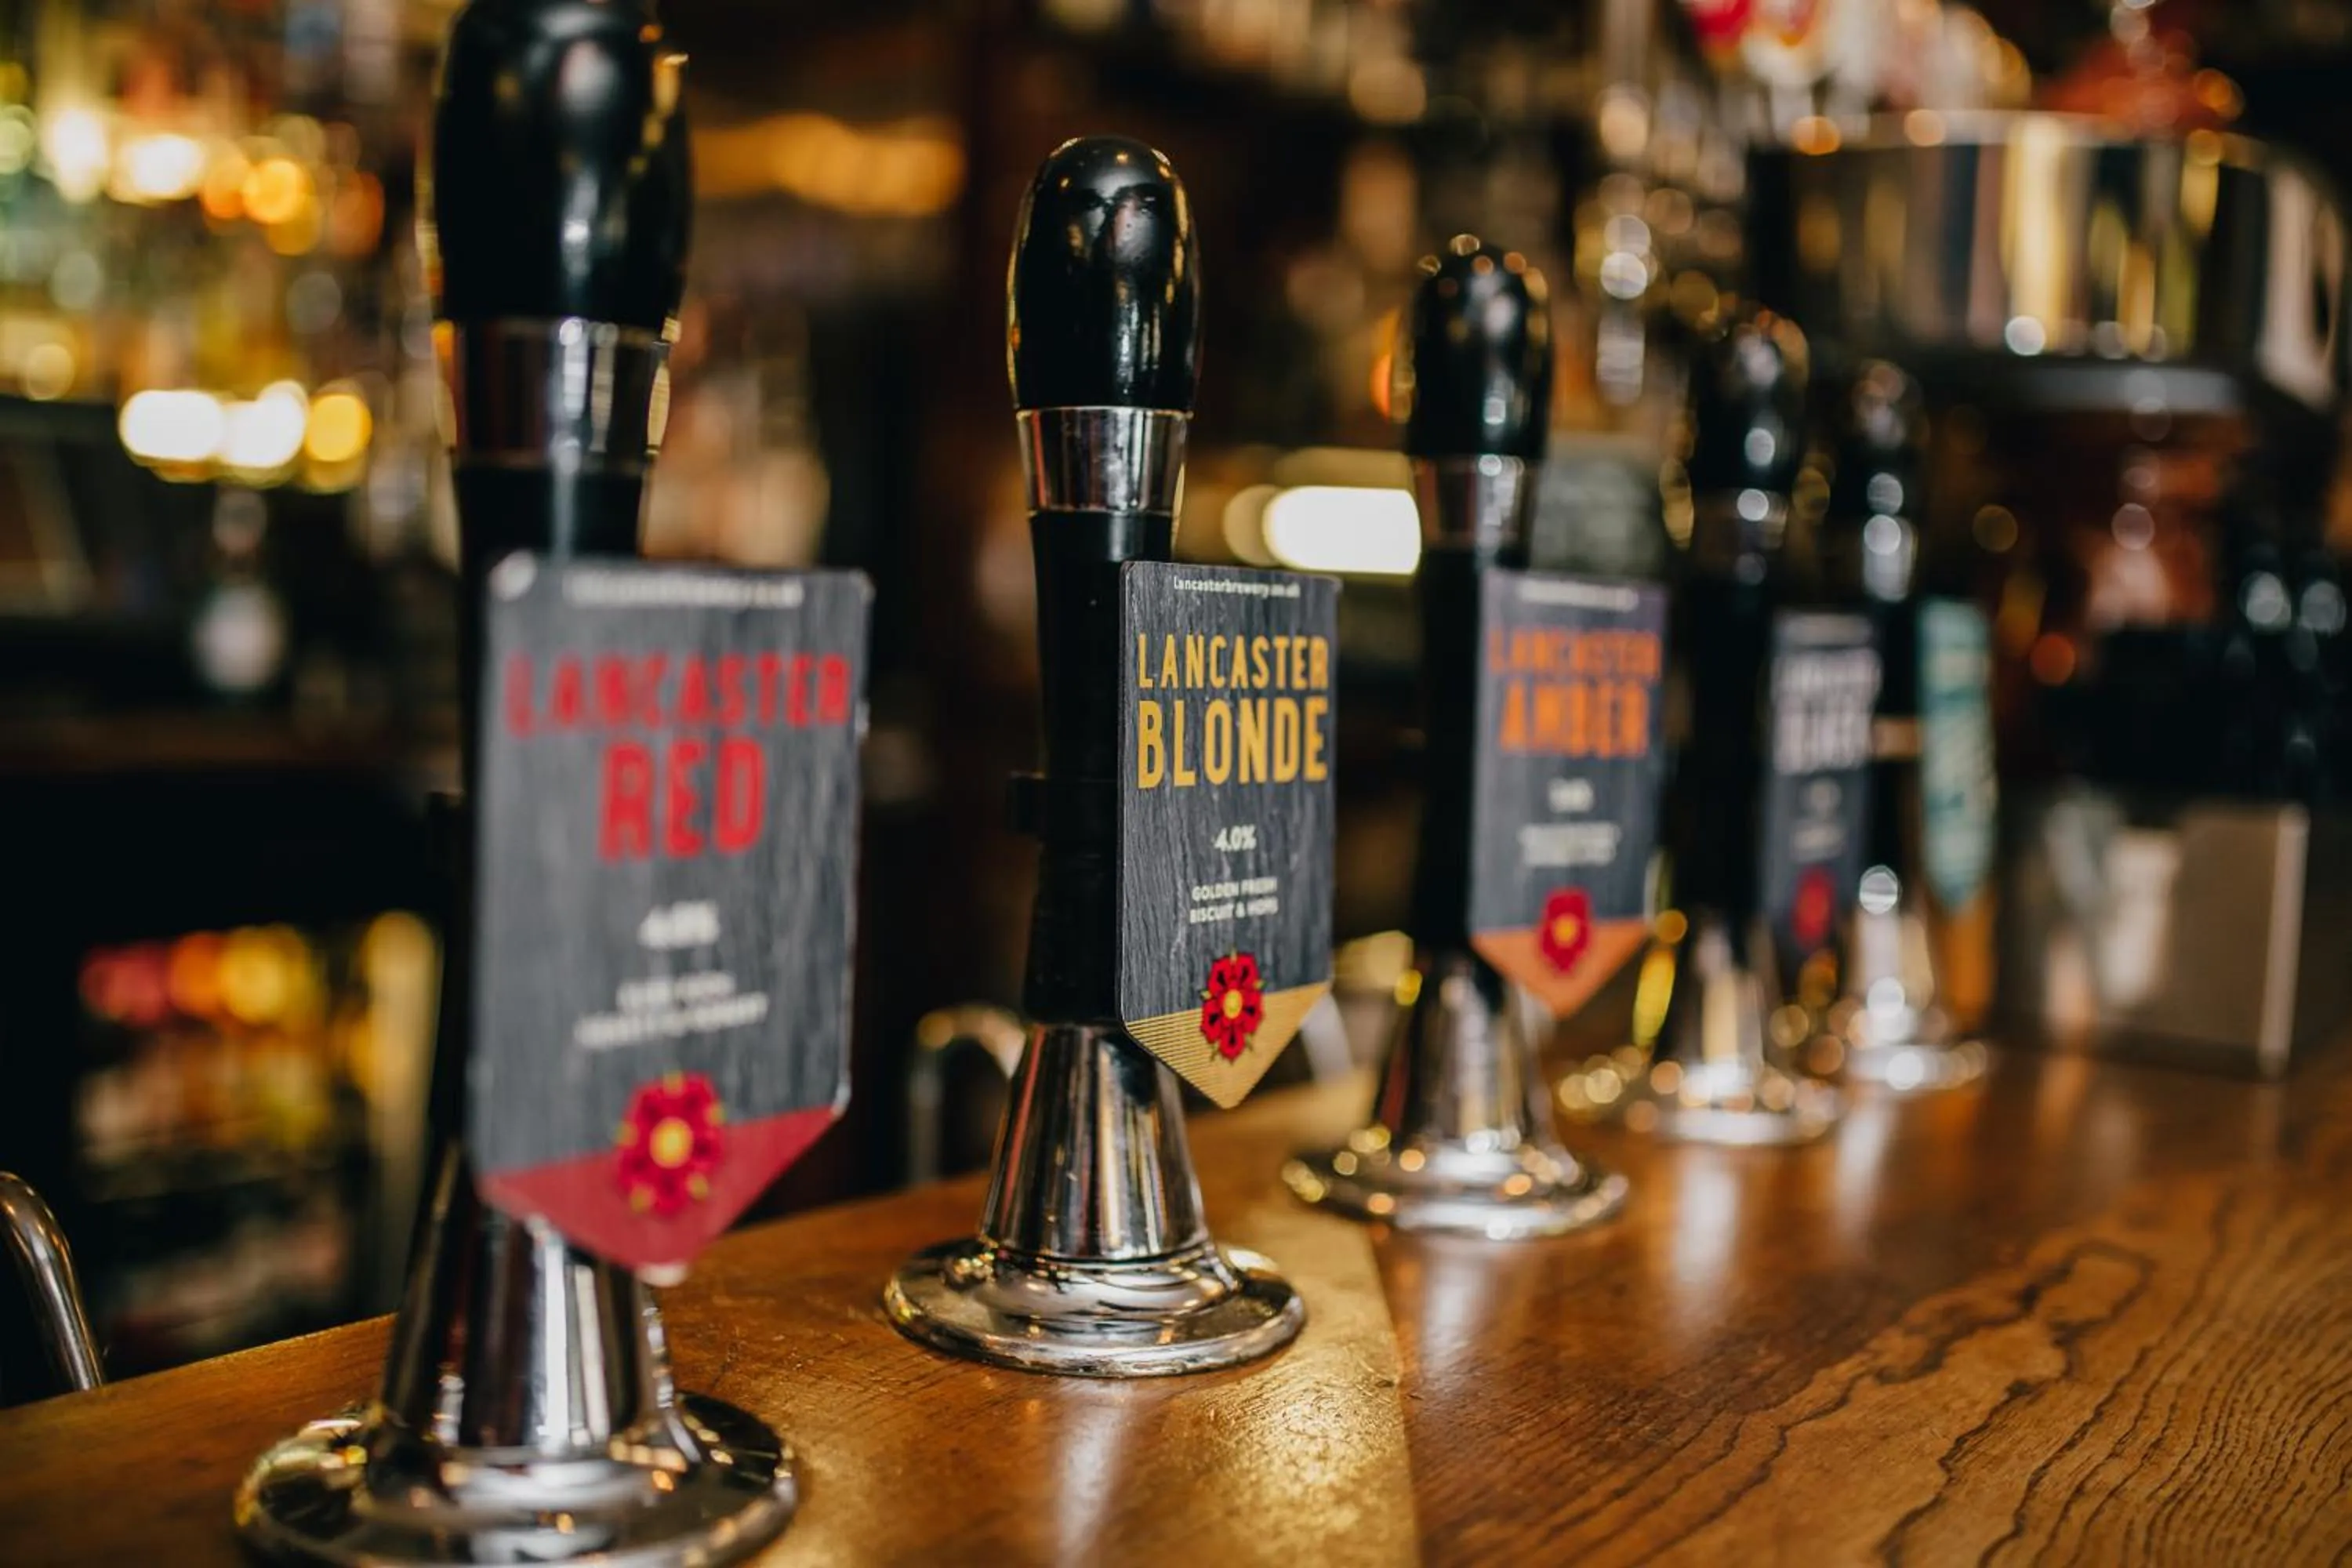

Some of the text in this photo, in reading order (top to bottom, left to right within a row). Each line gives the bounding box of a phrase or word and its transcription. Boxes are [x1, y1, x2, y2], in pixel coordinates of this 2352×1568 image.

[1138, 633, 1329, 689] LANCASTER
[504, 648, 851, 737] LANCASTER
[1138, 697, 1329, 789] BLONDE
[598, 736, 767, 864] RED
[1214, 824, 1257, 852] 4.0%
[1190, 902, 1234, 924] BISCUIT
[1192, 882, 1239, 902] GOLDEN
